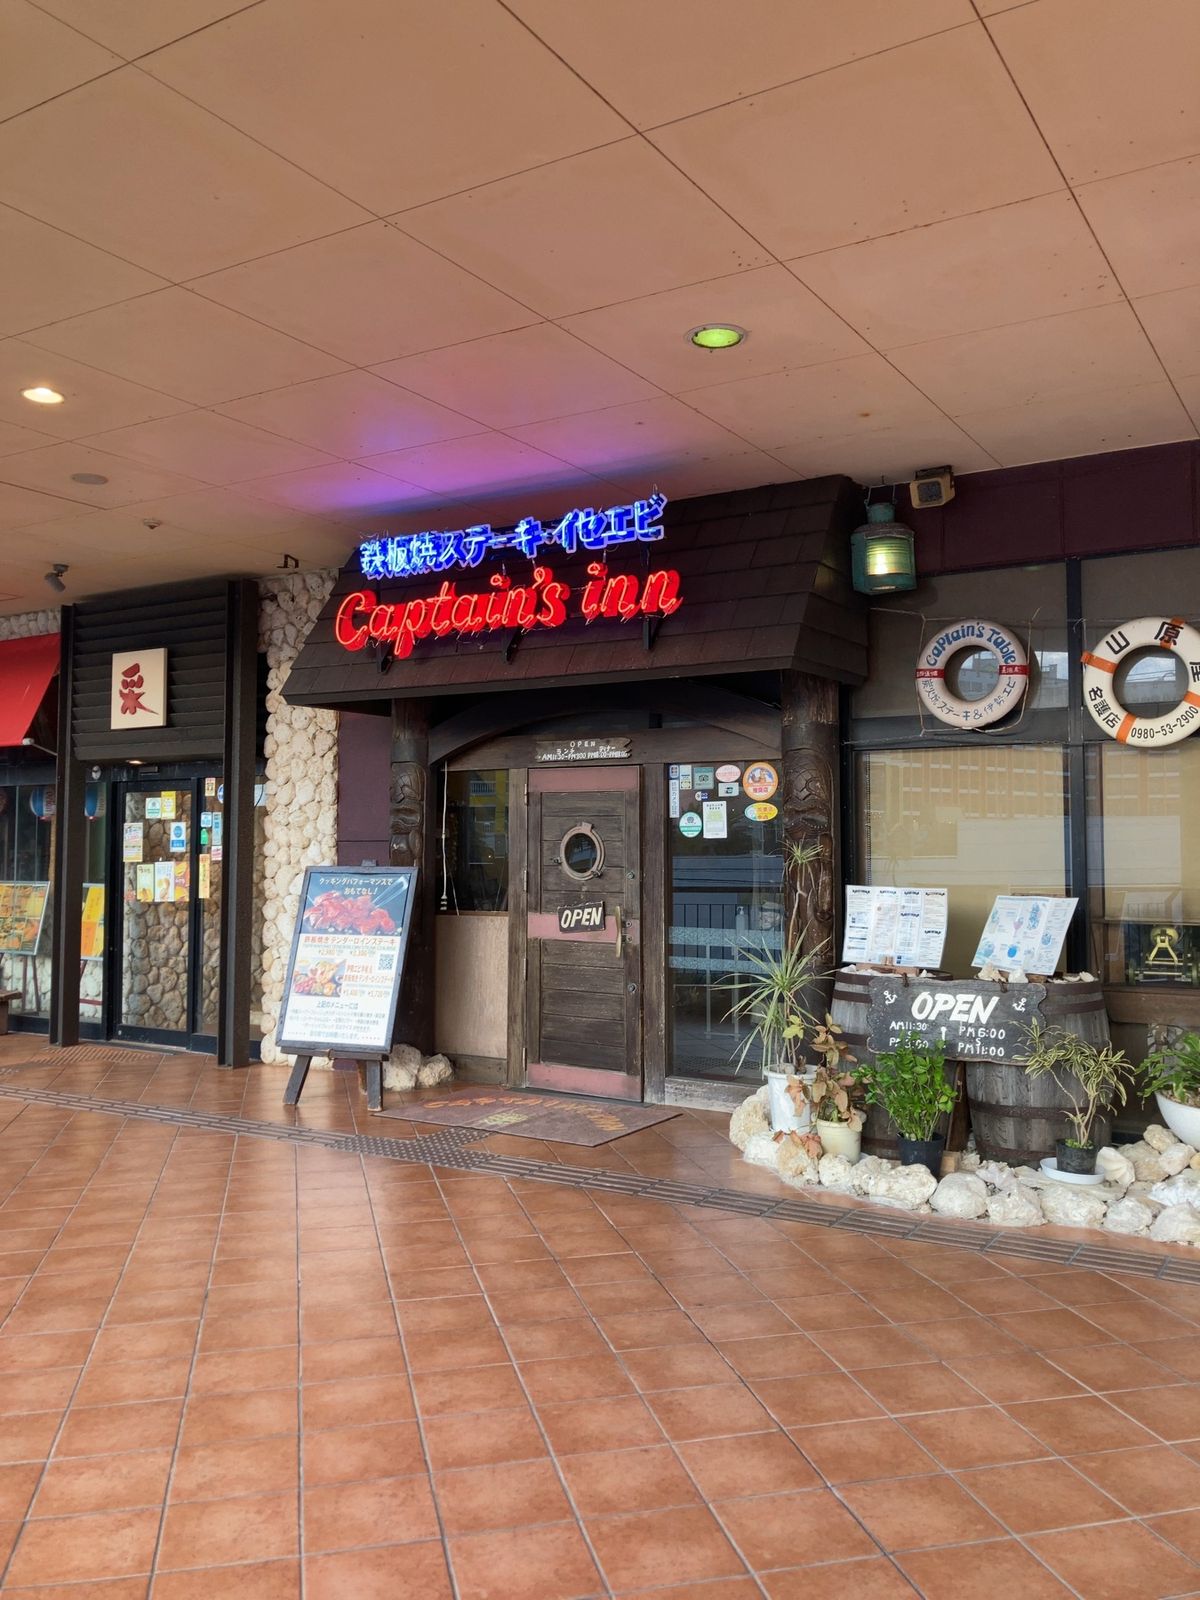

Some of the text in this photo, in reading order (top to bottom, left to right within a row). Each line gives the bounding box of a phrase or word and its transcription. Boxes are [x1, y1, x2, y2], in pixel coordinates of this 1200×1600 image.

[335, 562, 683, 658] Captain's inn
[926, 621, 1017, 667] Captain's Table
[1088, 686, 1121, 729] 名護店
[1131, 705, 1199, 740] 0980-53-2900
[570, 740, 596, 748] OPEN
[560, 906, 603, 928] OPEN
[911, 991, 1000, 1025] OPEN
[889, 1020, 1006, 1040] AM11:30 PM6:00
